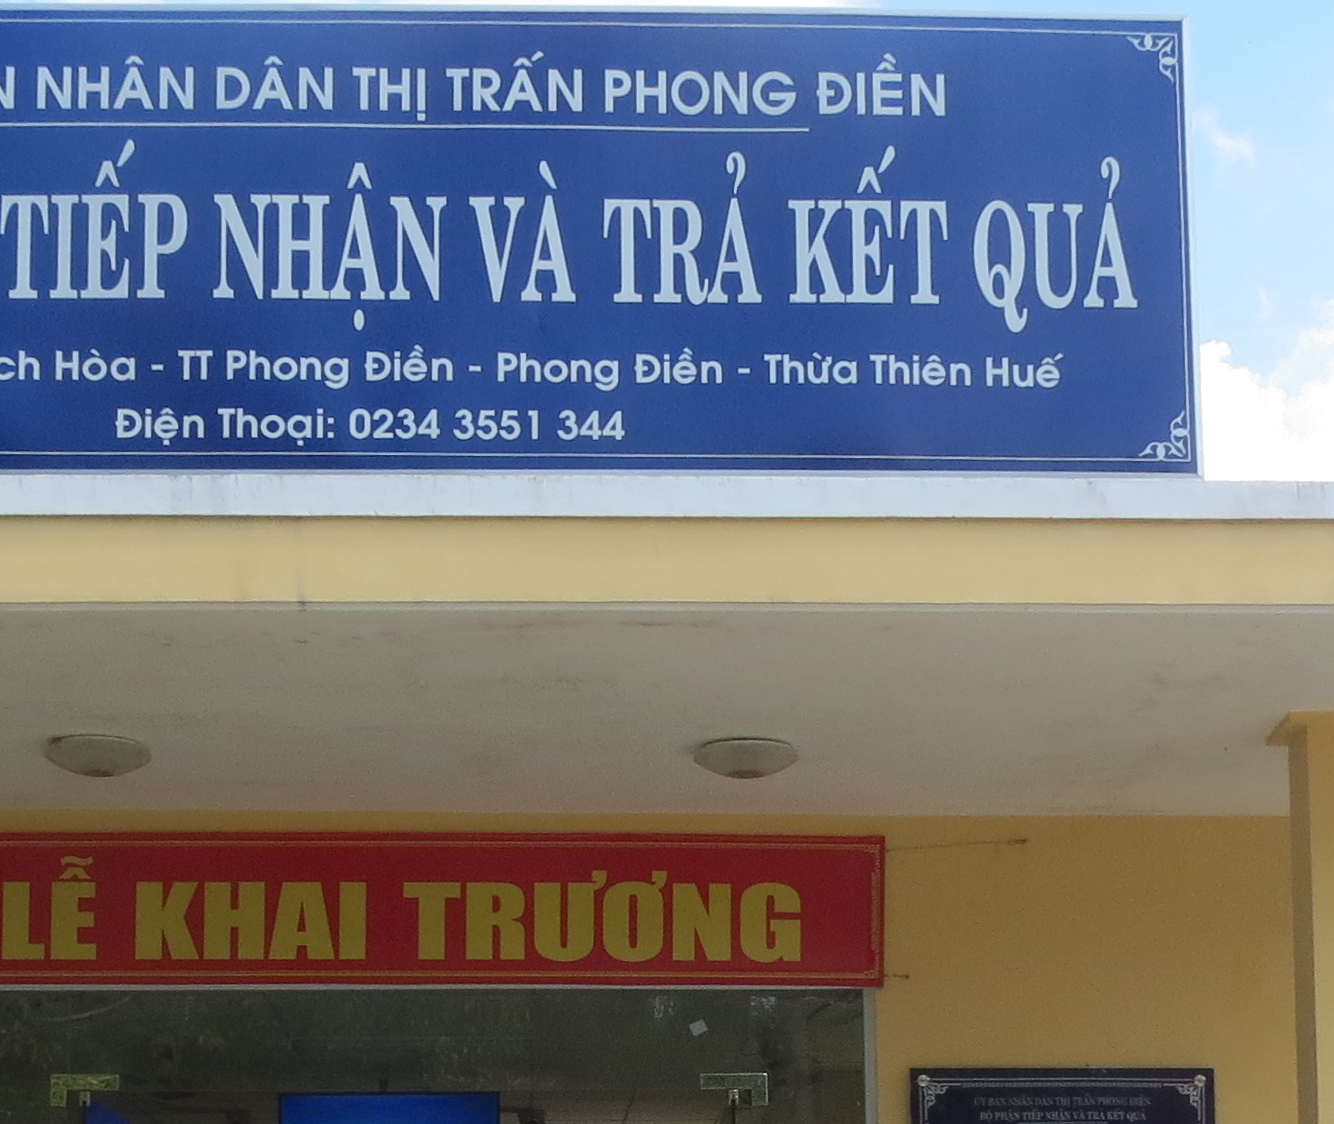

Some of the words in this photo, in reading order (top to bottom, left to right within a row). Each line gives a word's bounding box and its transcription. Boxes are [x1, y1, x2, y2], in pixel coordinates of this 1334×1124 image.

[37, 56, 193, 109] NHÂN
[217, 56, 333, 110] DÂN
[353, 67, 425, 121] THỊ
[446, 51, 582, 111] TRẤN
[605, 69, 796, 115] PHONG
[817, 53, 945, 116] ĐIỀN
[0, 139, 187, 298] TIẾP
[213, 163, 446, 330] NHẬN
[469, 161, 576, 302] VÀ
[604, 152, 761, 305] TRẢ
[788, 146, 947, 304] KẾT
[974, 157, 1137, 332] QUẢ
[56, 349, 135, 380] Hòa
[178, 350, 213, 380] TT
[227, 350, 349, 389] Phong
[365, 345, 453, 381] Điền
[498, 352, 618, 391] Phong
[635, 348, 722, 384] Điền
[764, 352, 857, 384] Thừa
[870, 355, 971, 386] Thiên
[986, 353, 1063, 387] Huế
[115, 408, 204, 445] Điện
[218, 408, 334, 446] Thoại:
[350, 409, 440, 439] 0234
[453, 409, 538, 440] 3551
[557, 410, 625, 440] 344
[2, 856, 96, 960] LỄ
[135, 882, 366, 960] KHAI
[404, 871, 801, 963] TRƯƠNG
